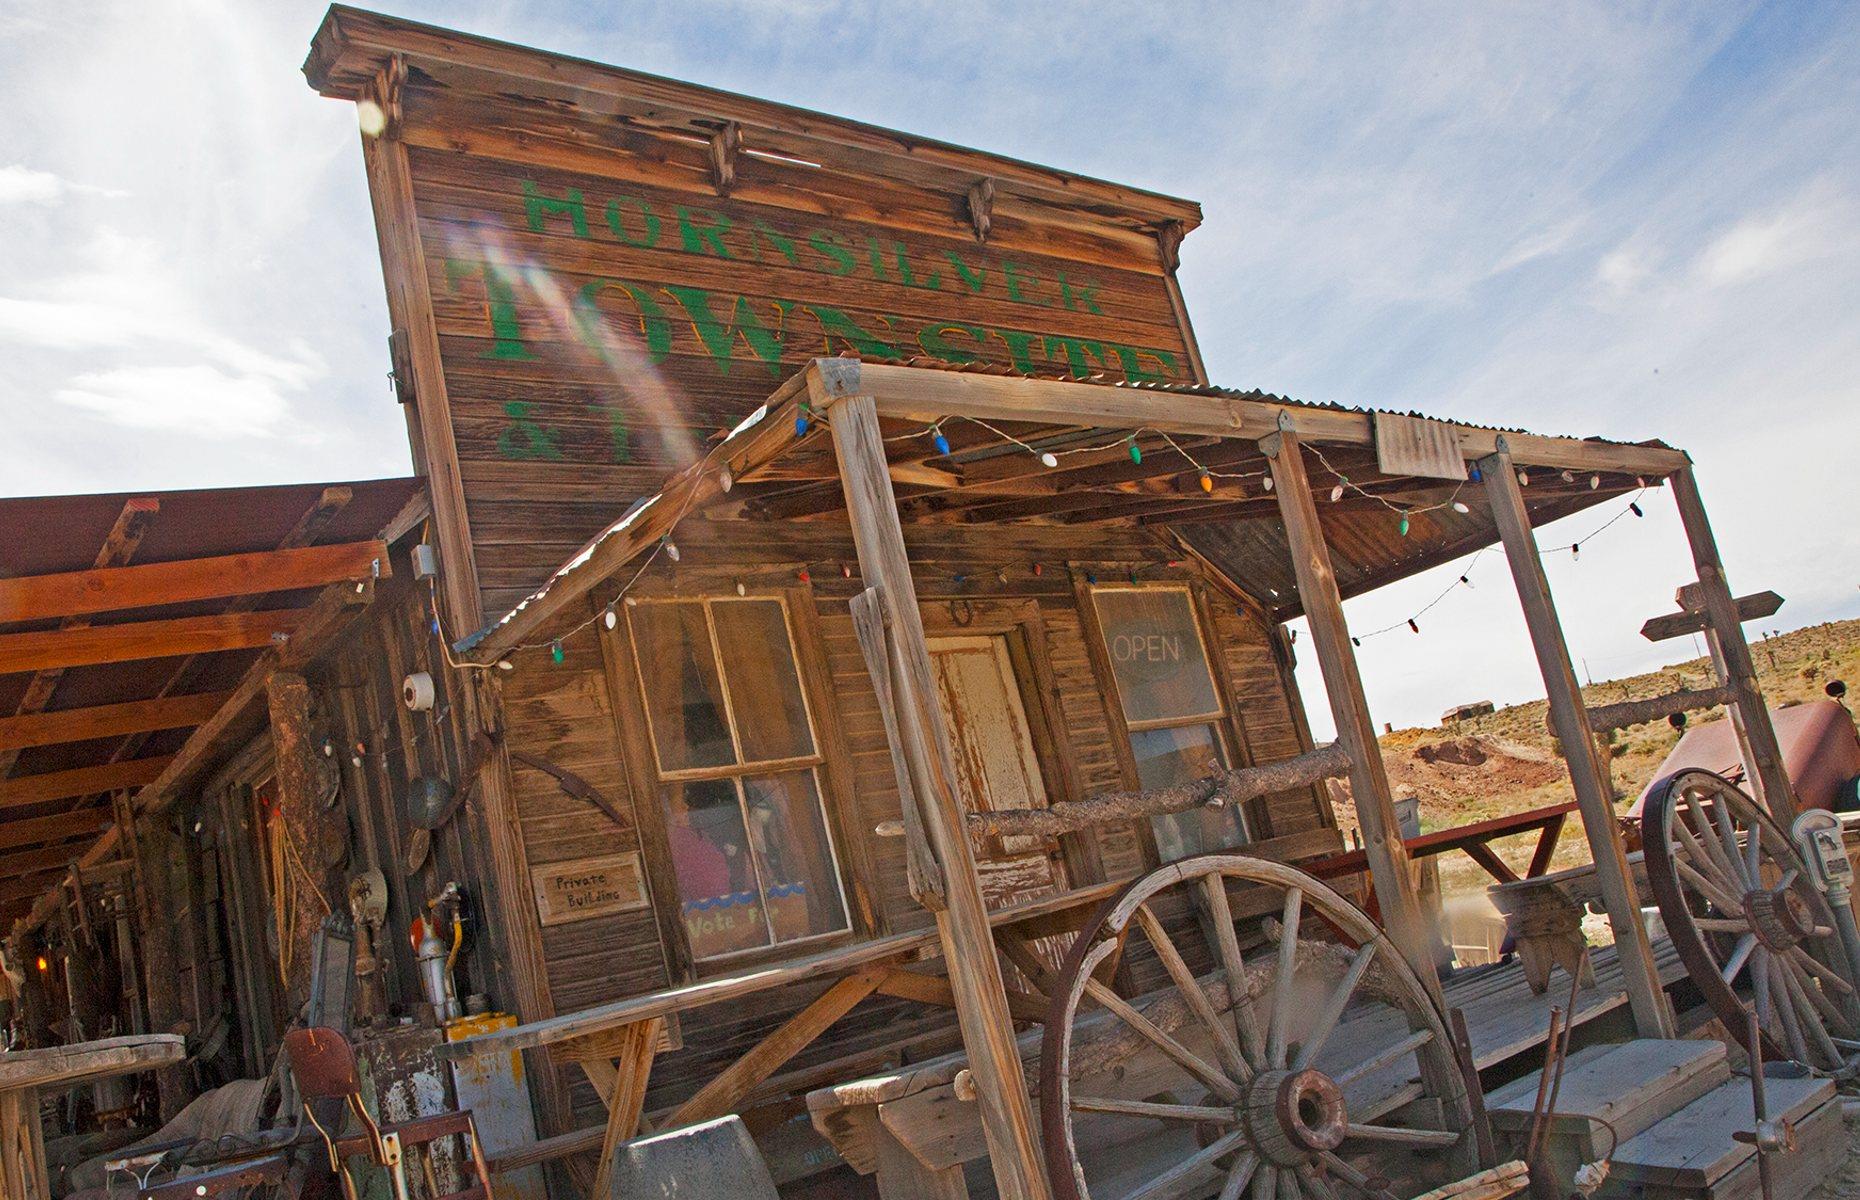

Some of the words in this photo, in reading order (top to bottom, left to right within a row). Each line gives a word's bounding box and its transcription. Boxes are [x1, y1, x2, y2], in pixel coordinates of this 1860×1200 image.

[522, 179, 1104, 315] HORNSILVER
[441, 256, 1180, 386] TOWNSITE
[1113, 635, 1180, 661] OPEN
[556, 875, 605, 889] Private
[687, 911, 736, 938] Vote
